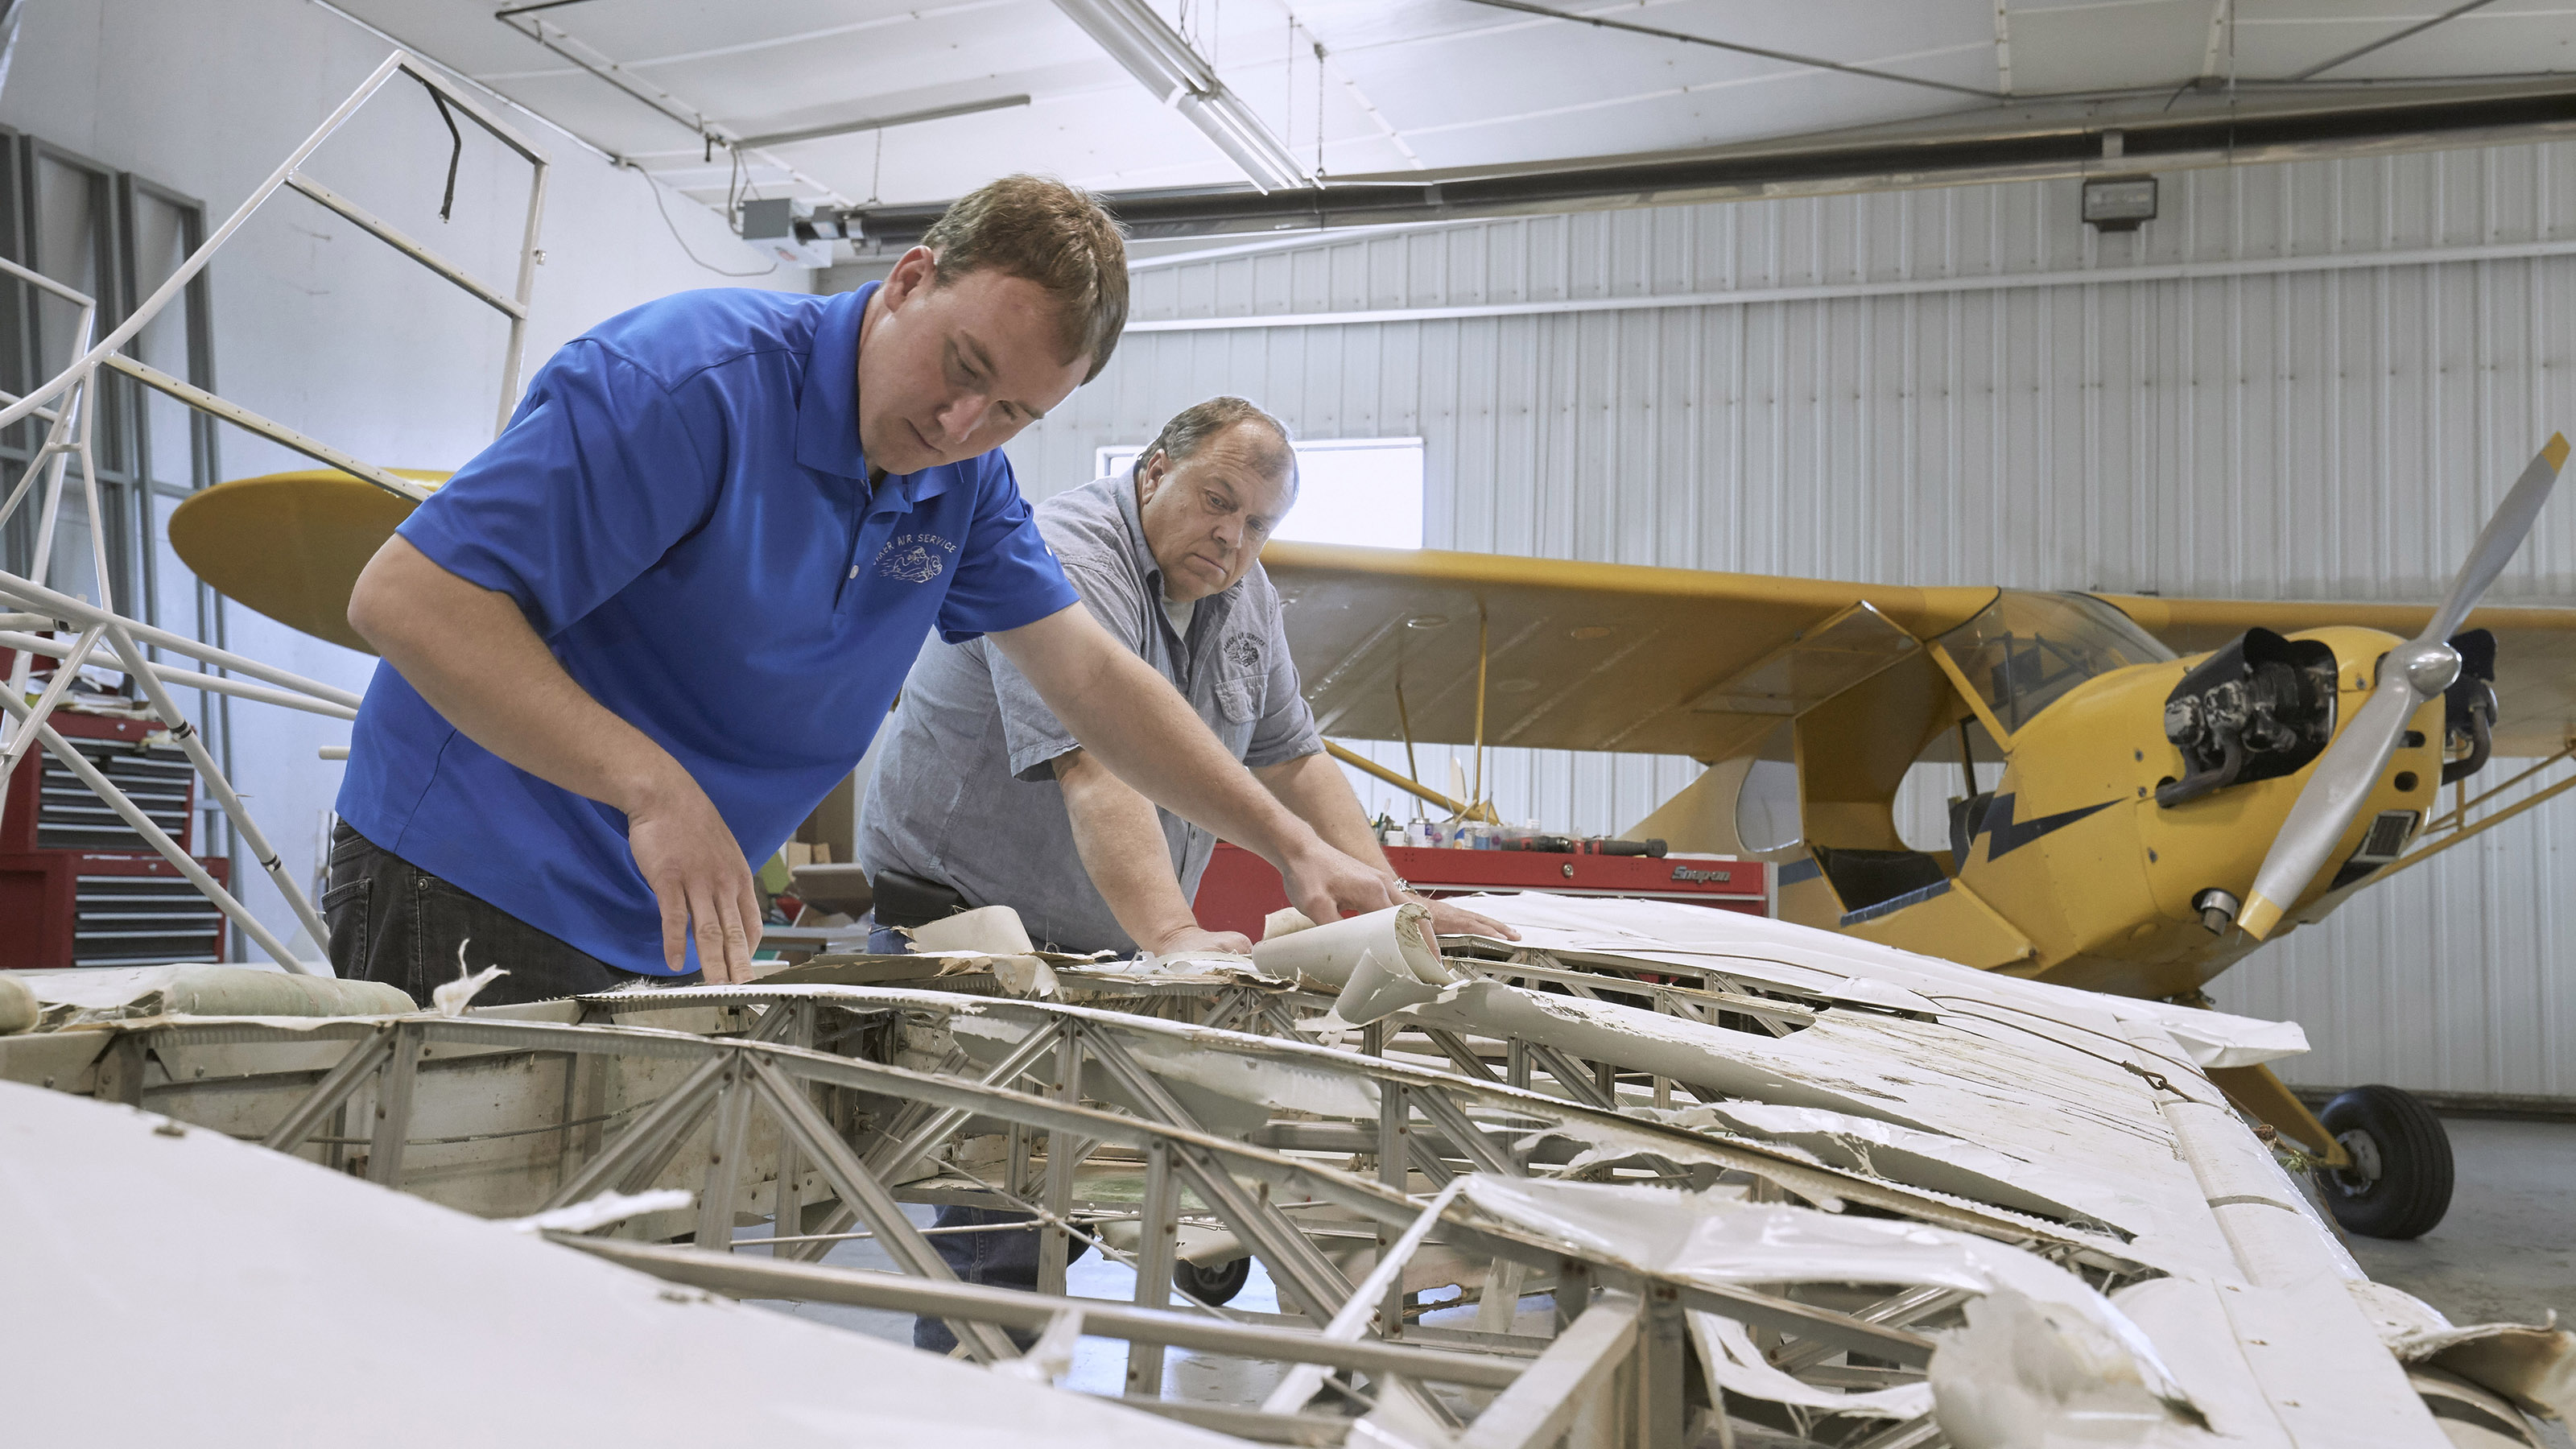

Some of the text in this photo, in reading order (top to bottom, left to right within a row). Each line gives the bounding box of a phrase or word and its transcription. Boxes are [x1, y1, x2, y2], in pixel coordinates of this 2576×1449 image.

[873, 534, 957, 566] AKER AIR SERVICE
